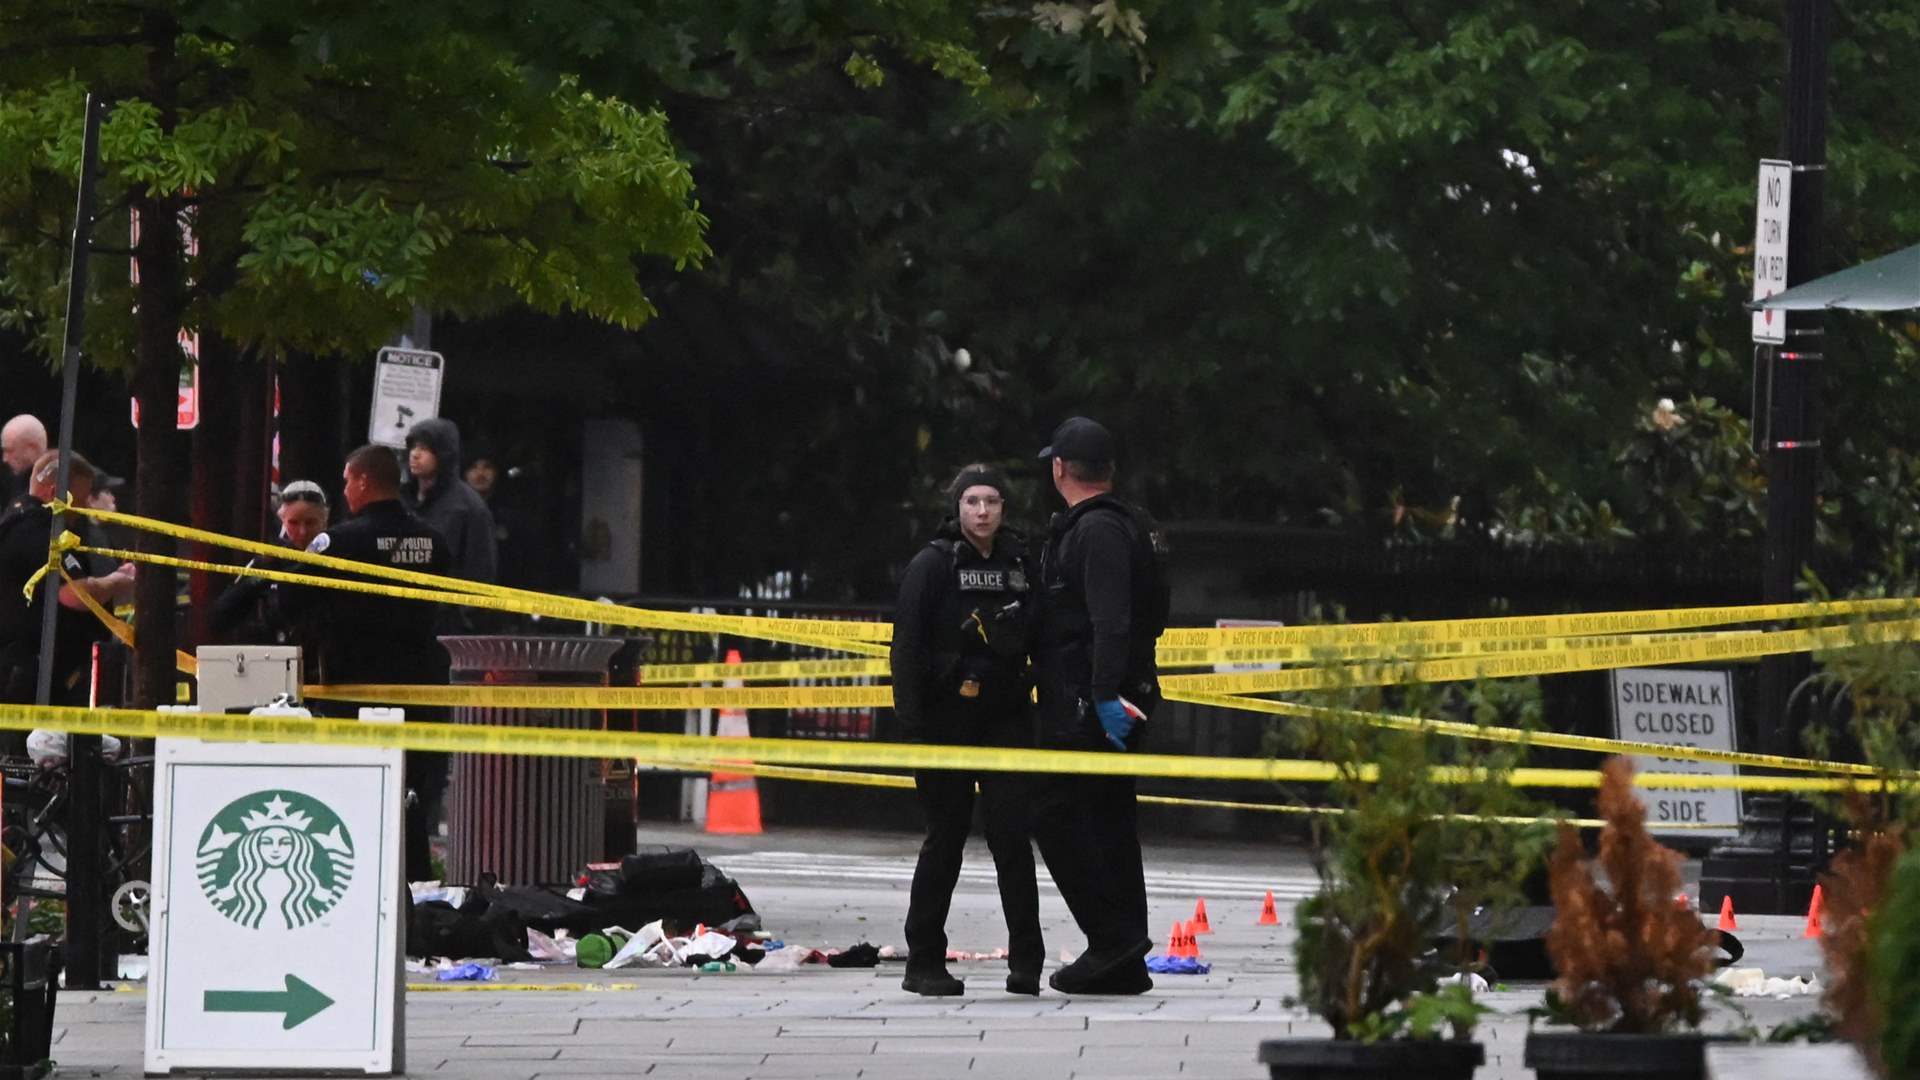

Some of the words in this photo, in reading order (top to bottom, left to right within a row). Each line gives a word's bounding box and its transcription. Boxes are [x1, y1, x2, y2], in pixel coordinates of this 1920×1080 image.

[1766, 176, 1782, 208] NO
[1763, 218, 1782, 245] TURN
[1757, 255, 1768, 281] ON
[1769, 255, 1784, 281] RED
[386, 351, 434, 367] NOTICE
[377, 537, 433, 550] METPOLITAN
[390, 550, 434, 563] OLICE
[960, 573, 1003, 586] POLICE
[1622, 682, 1723, 705] SIDEWALK
[1635, 711, 1714, 735] CLOSED
[1659, 801, 1707, 822] SIDE
